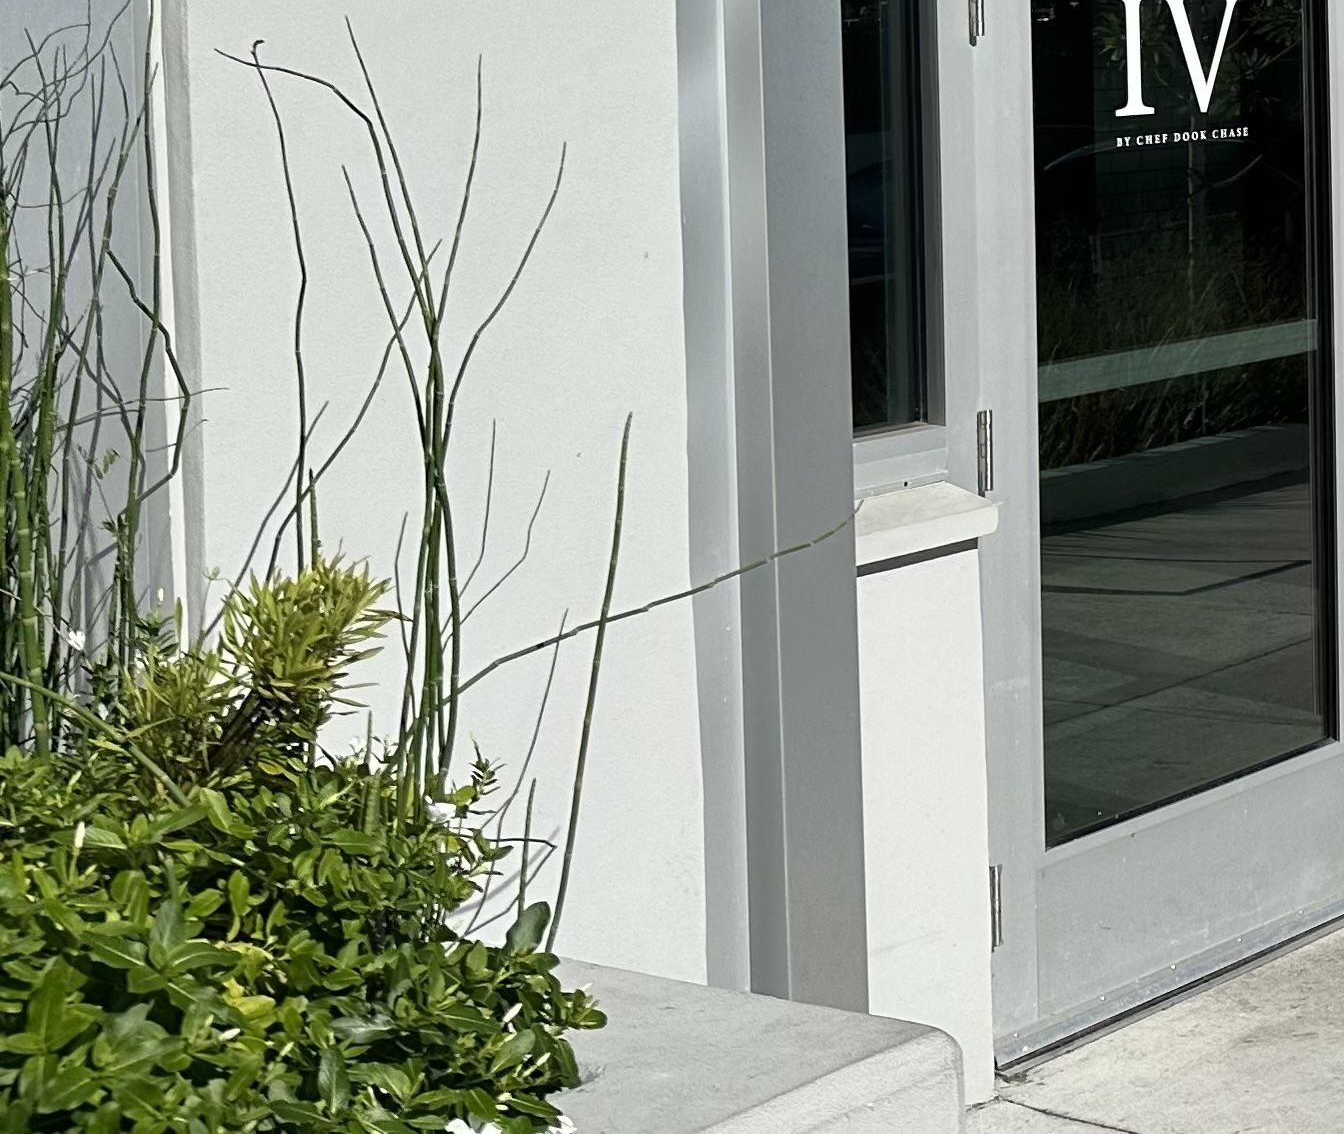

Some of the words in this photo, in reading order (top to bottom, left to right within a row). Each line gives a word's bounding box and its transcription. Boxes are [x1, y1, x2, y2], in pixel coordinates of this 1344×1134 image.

[1116, 136, 1131, 148] BY
[1136, 133, 1168, 146] CHEF
[1173, 130, 1207, 143] DOOK
[1211, 126, 1249, 139] CHASE
